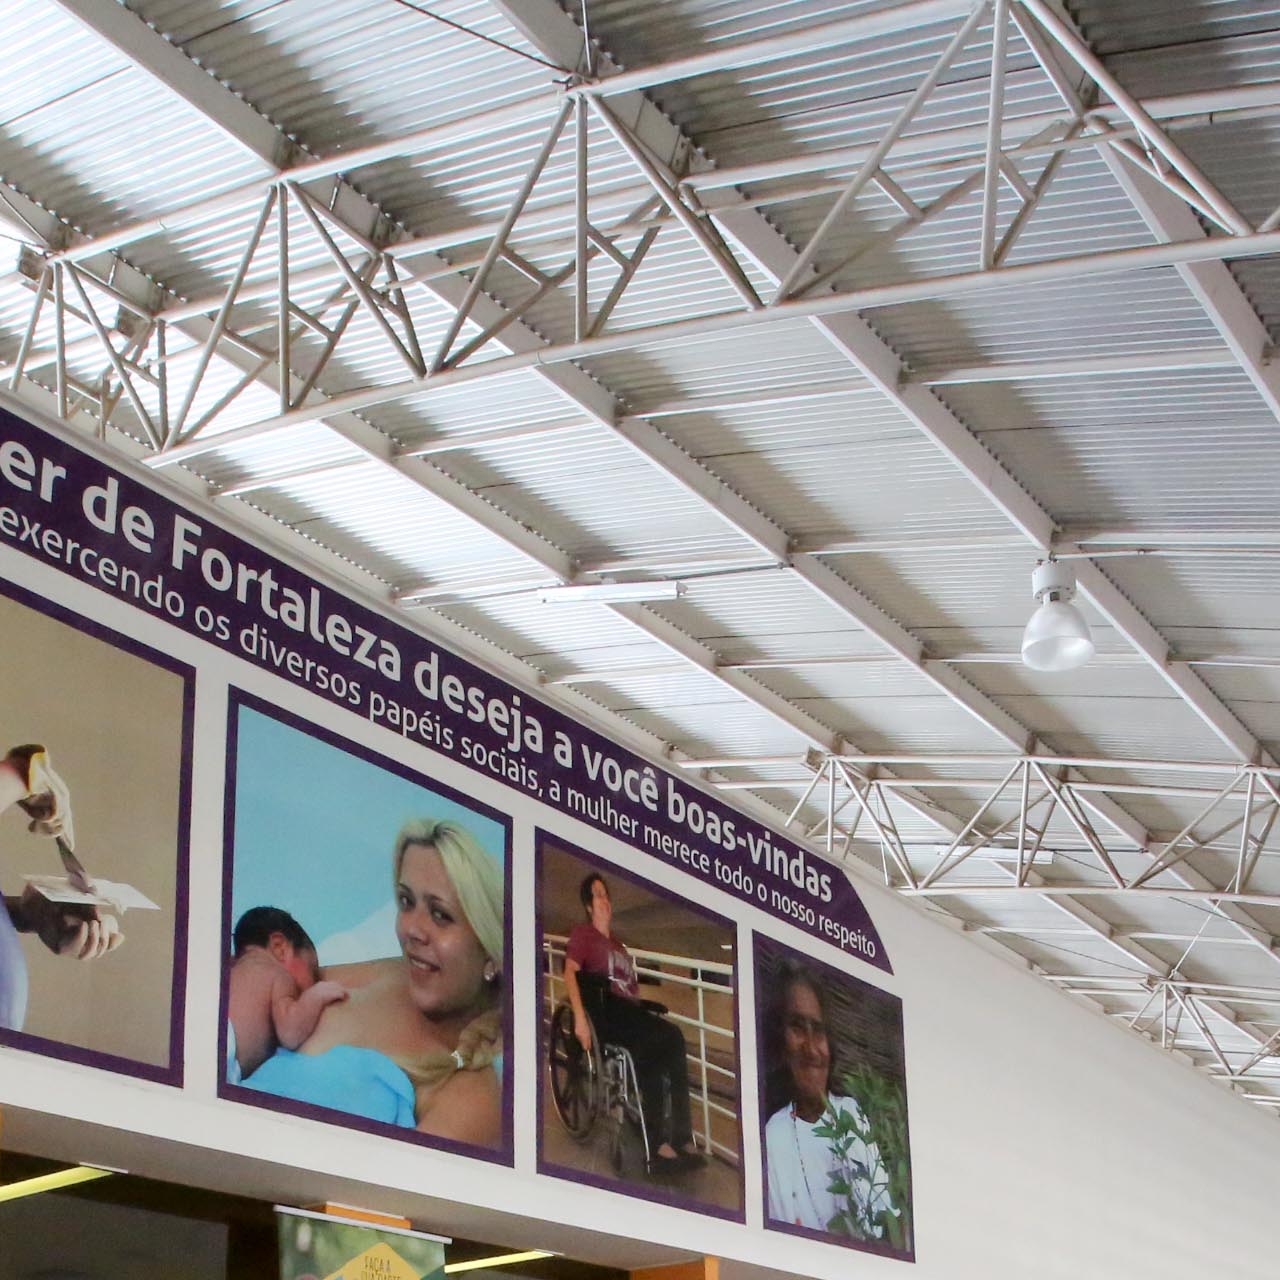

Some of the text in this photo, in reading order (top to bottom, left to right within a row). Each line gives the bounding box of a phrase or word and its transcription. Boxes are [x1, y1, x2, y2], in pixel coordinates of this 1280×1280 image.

[82, 476, 155, 554] de
[171, 513, 402, 682] Fortaleza
[413, 653, 544, 754] deseja
[553, 730, 573, 769] a
[581, 743, 659, 812] você
[667, 776, 833, 903] boas-vindas
[194, 605, 230, 641] os
[240, 623, 361, 705] diversos
[370, 689, 454, 751] papéis
[461, 736, 543, 799] sociais,
[548, 779, 561, 802] a
[567, 787, 639, 839] mulher
[644, 824, 711, 875] merece
[715, 858, 754, 895] todo
[757, 882, 768, 902] o
[772, 889, 816, 927] nosso
[819, 914, 877, 959] respeito
